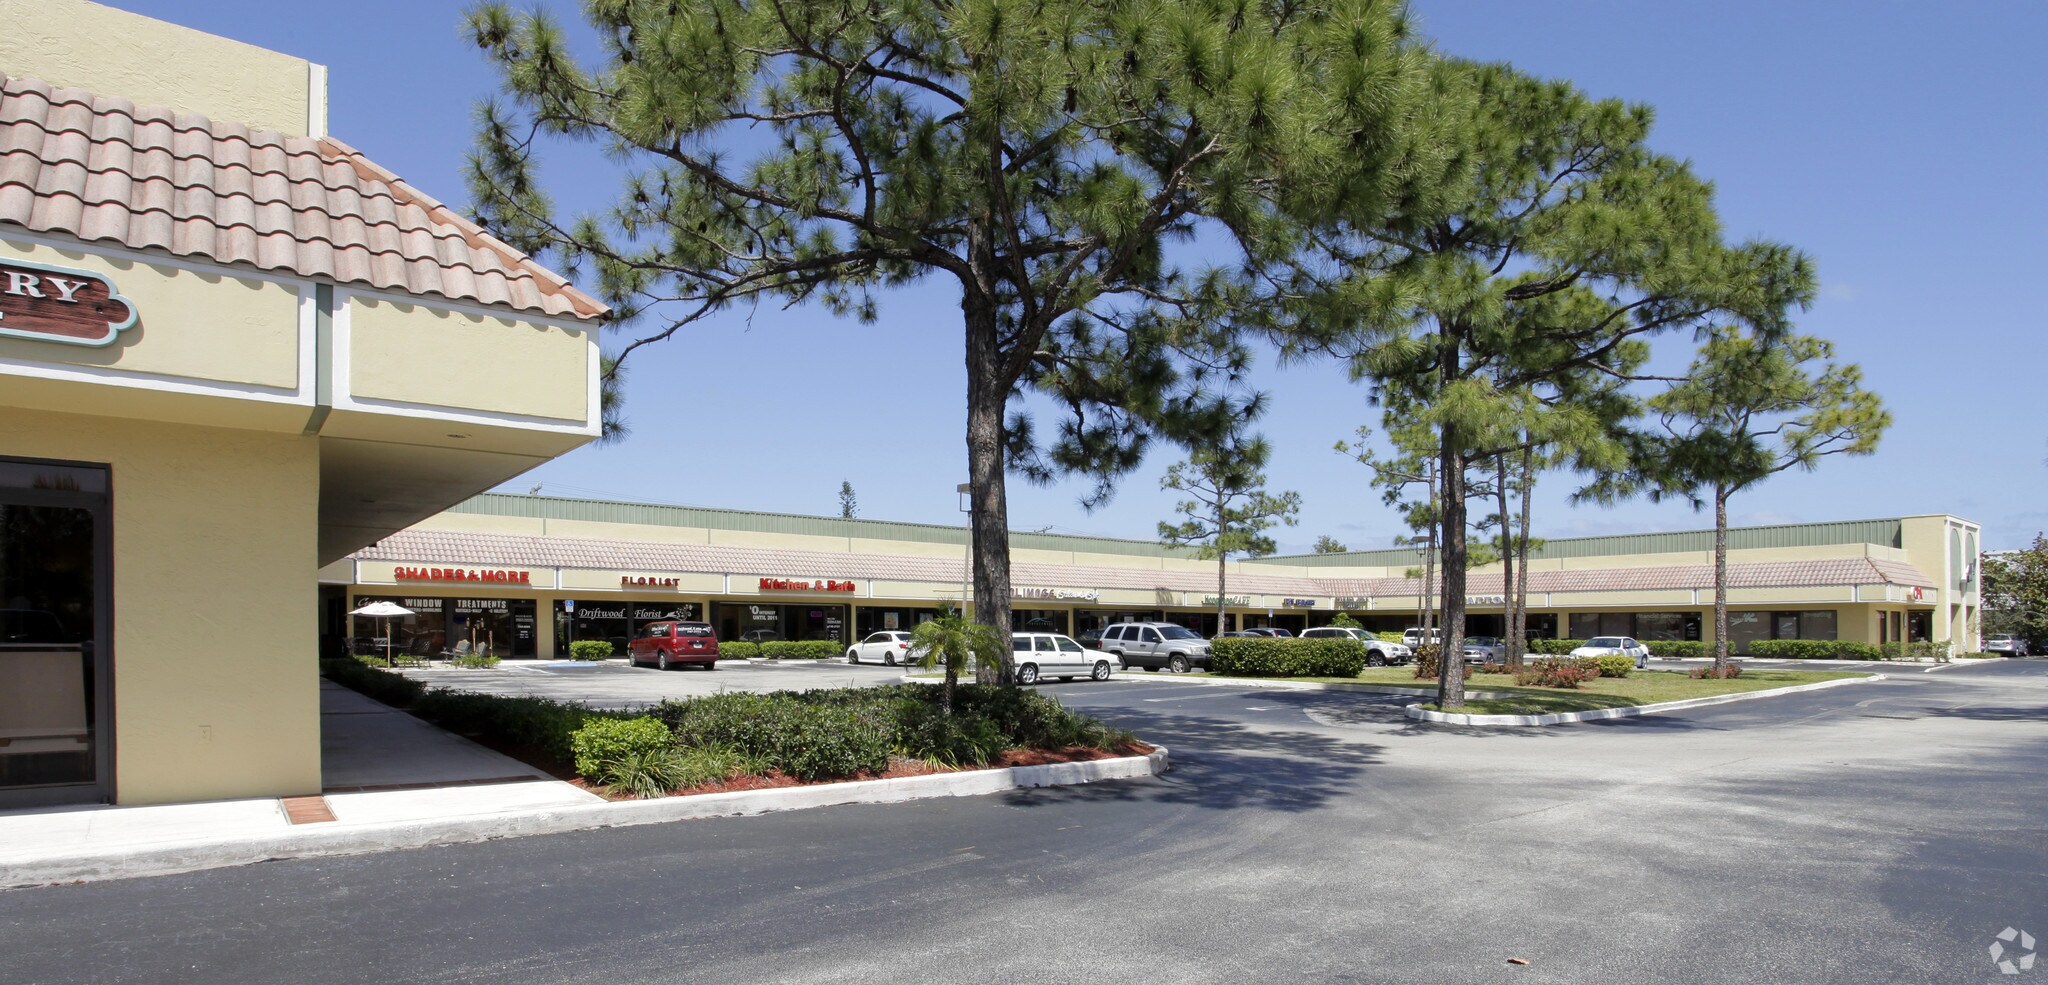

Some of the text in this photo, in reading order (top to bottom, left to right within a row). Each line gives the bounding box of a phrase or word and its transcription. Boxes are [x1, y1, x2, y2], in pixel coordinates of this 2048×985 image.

[621, 576, 681, 587] FLORIST
[759, 577, 856, 592] Kitchen & Bath
[404, 598, 443, 608] WINDOW
[457, 599, 507, 609] TREATMENTS
[578, 607, 662, 620] Driftwood Florist
